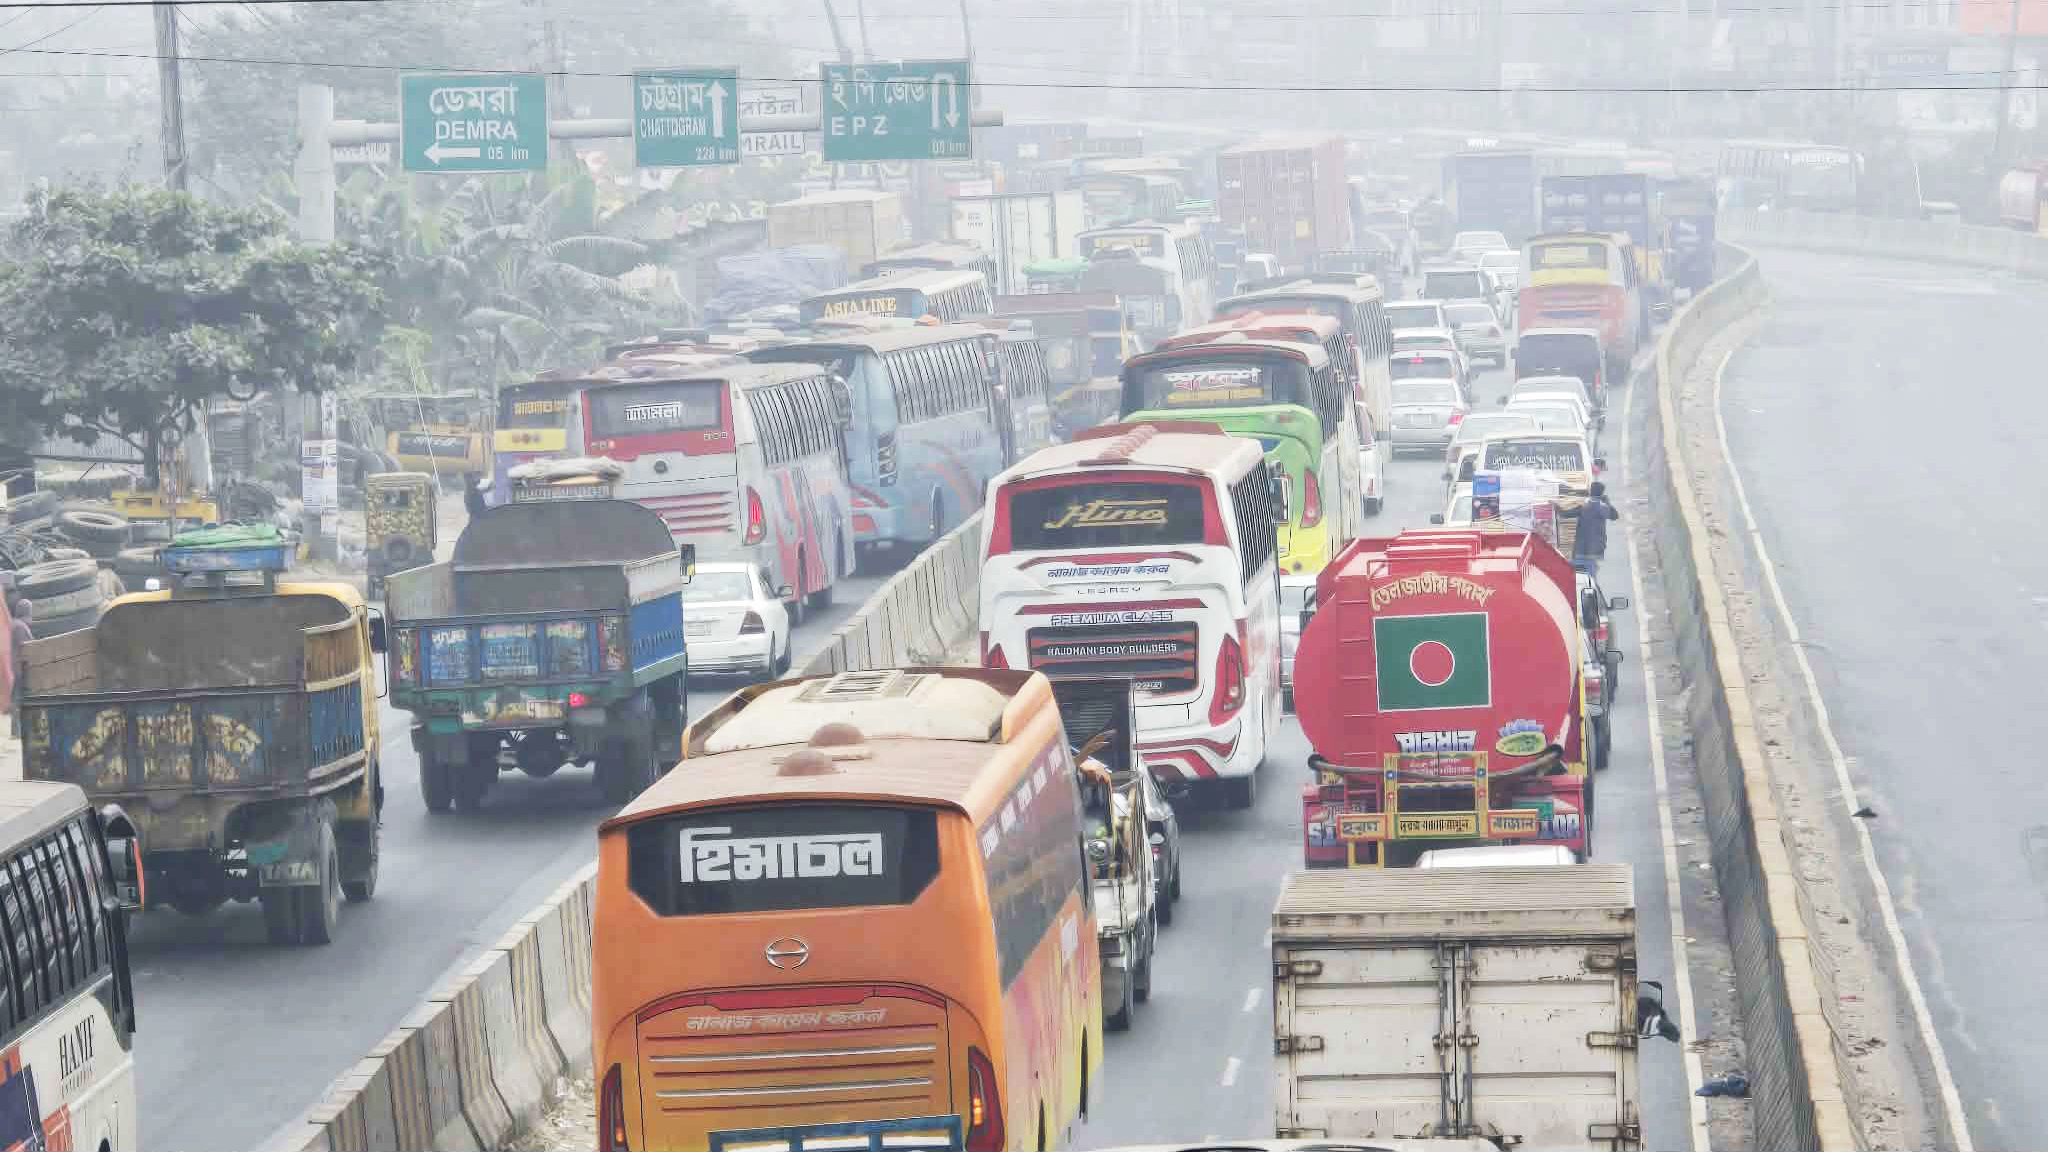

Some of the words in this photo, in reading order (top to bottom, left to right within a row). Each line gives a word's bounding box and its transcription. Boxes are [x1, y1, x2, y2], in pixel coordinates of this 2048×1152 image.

[429, 82, 519, 115] ডেমরা
[435, 120, 518, 141] DEMRA
[639, 117, 707, 137] CHATTOGRAM
[487, 145, 504, 160] 05
[511, 145, 529, 160] km
[823, 299, 858, 319] ASIA
[862, 296, 897, 314] LINE
[1042, 500, 1168, 529] Hino
[1050, 612, 1120, 627] PREMIUM
[1121, 610, 1173, 624] CLASS
[1099, 645, 1127, 656] BODY
[1128, 643, 1177, 655] BUILDERS
[679, 826, 885, 884] হিমাচল
[58, 1014, 95, 1081] HANIF
